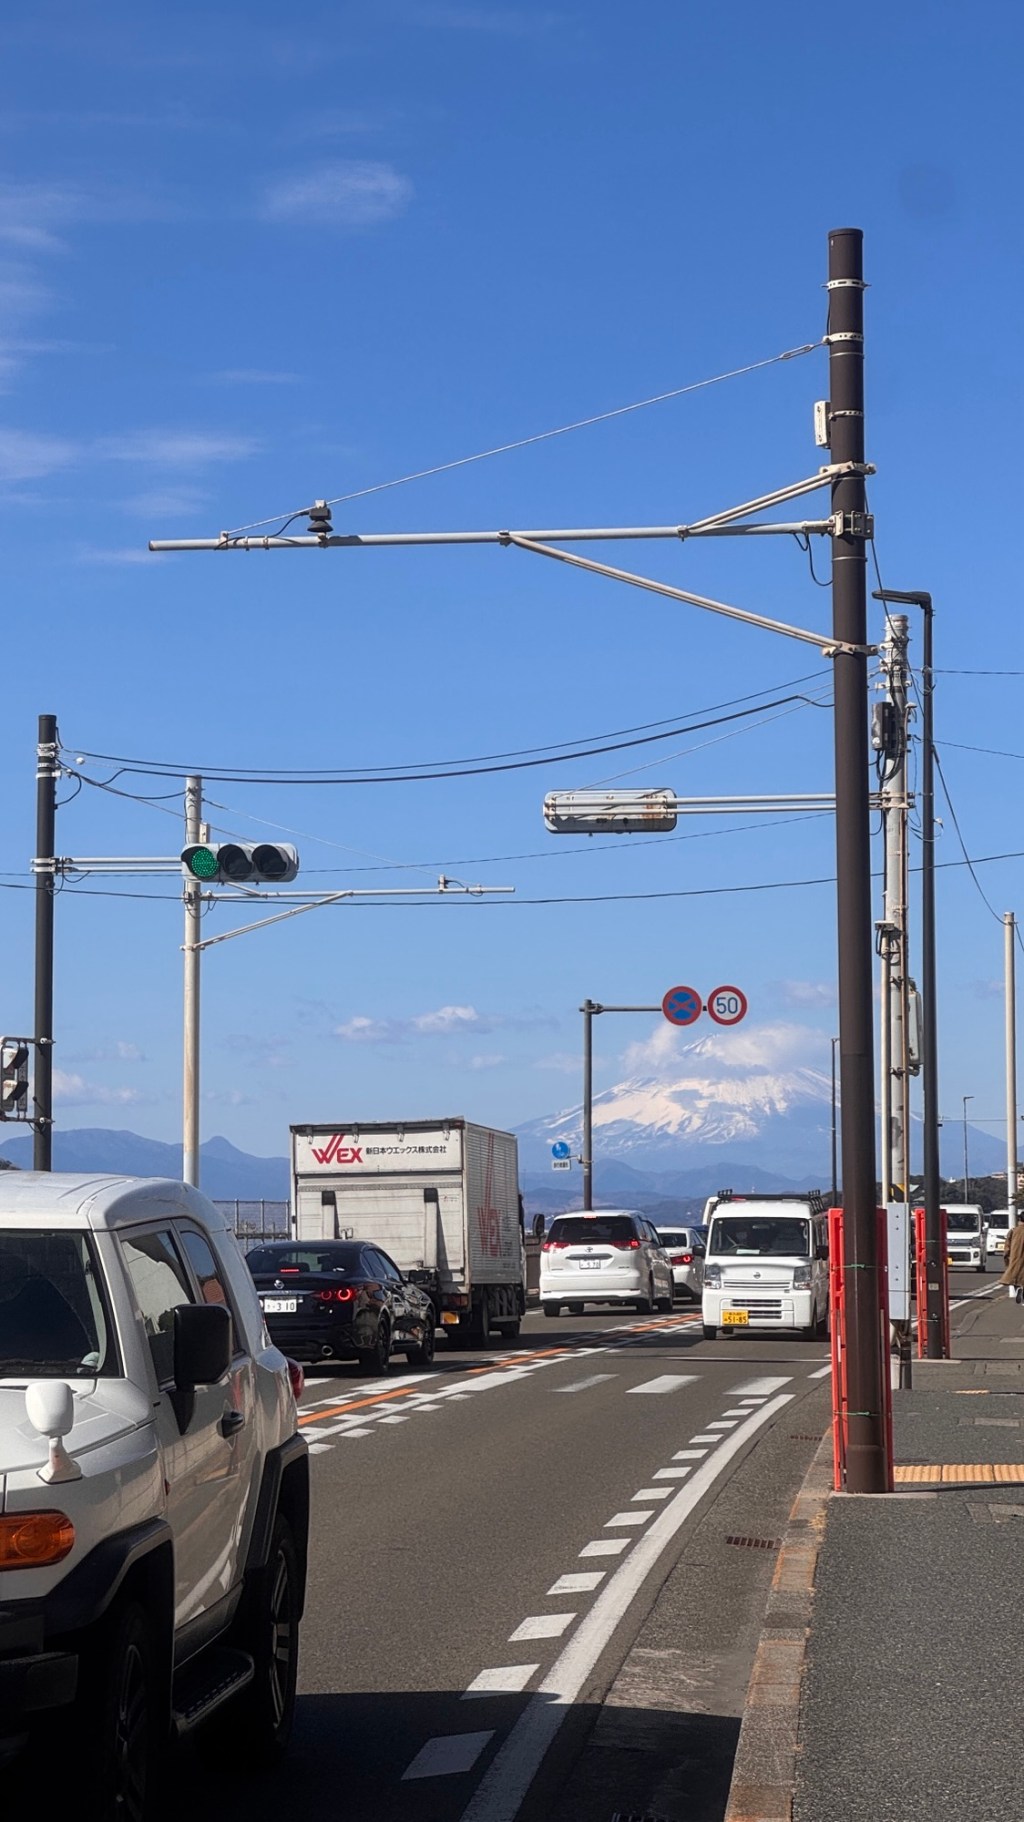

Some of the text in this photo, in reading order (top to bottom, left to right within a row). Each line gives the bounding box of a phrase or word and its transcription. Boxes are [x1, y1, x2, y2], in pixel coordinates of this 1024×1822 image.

[716, 997, 738, 1014] 50
[312, 1133, 363, 1164] WEX
[366, 1145, 447, 1155] 新日本ウエックス株式会社
